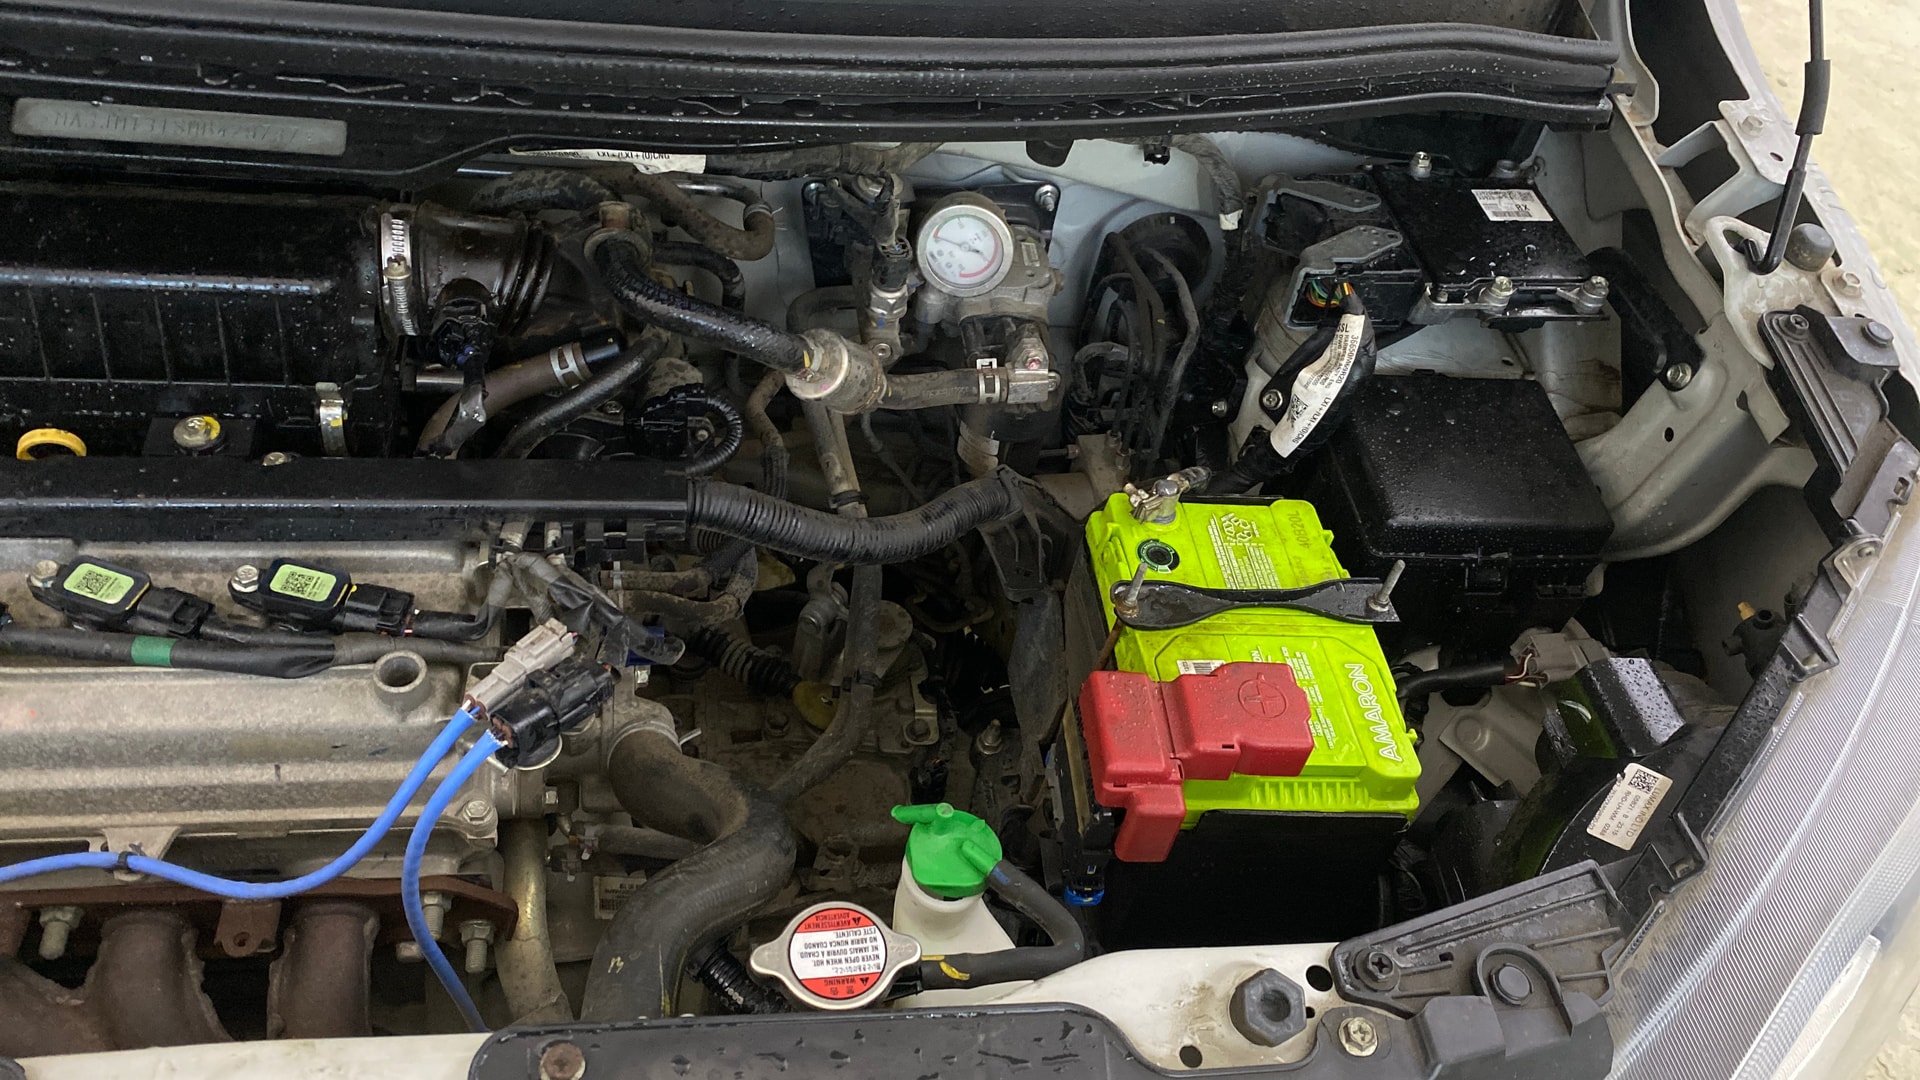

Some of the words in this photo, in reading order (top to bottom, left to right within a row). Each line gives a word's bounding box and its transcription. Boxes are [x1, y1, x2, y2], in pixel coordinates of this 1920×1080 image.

[1292, 510, 1311, 549] 40B20L
[1344, 663, 1402, 762] AMARON
[1643, 787, 1661, 810] LUMAX
[815, 911, 849, 921] ADVERTENCIA
[803, 919, 851, 929] AVERTISSEMENT
[803, 940, 827, 949] CUANDO
[828, 938, 848, 947] NUNCA
[850, 937, 867, 945] ABRIR
[826, 948, 847, 956] OUVRIR
[848, 945, 869, 953] JAMAIS
[811, 958, 824, 966] HOT.
[825, 957, 842, 965] WHEN
[844, 955, 859, 963] OPEN
[861, 953, 879, 962] NEVER
[823, 977, 855, 985] WARNING
